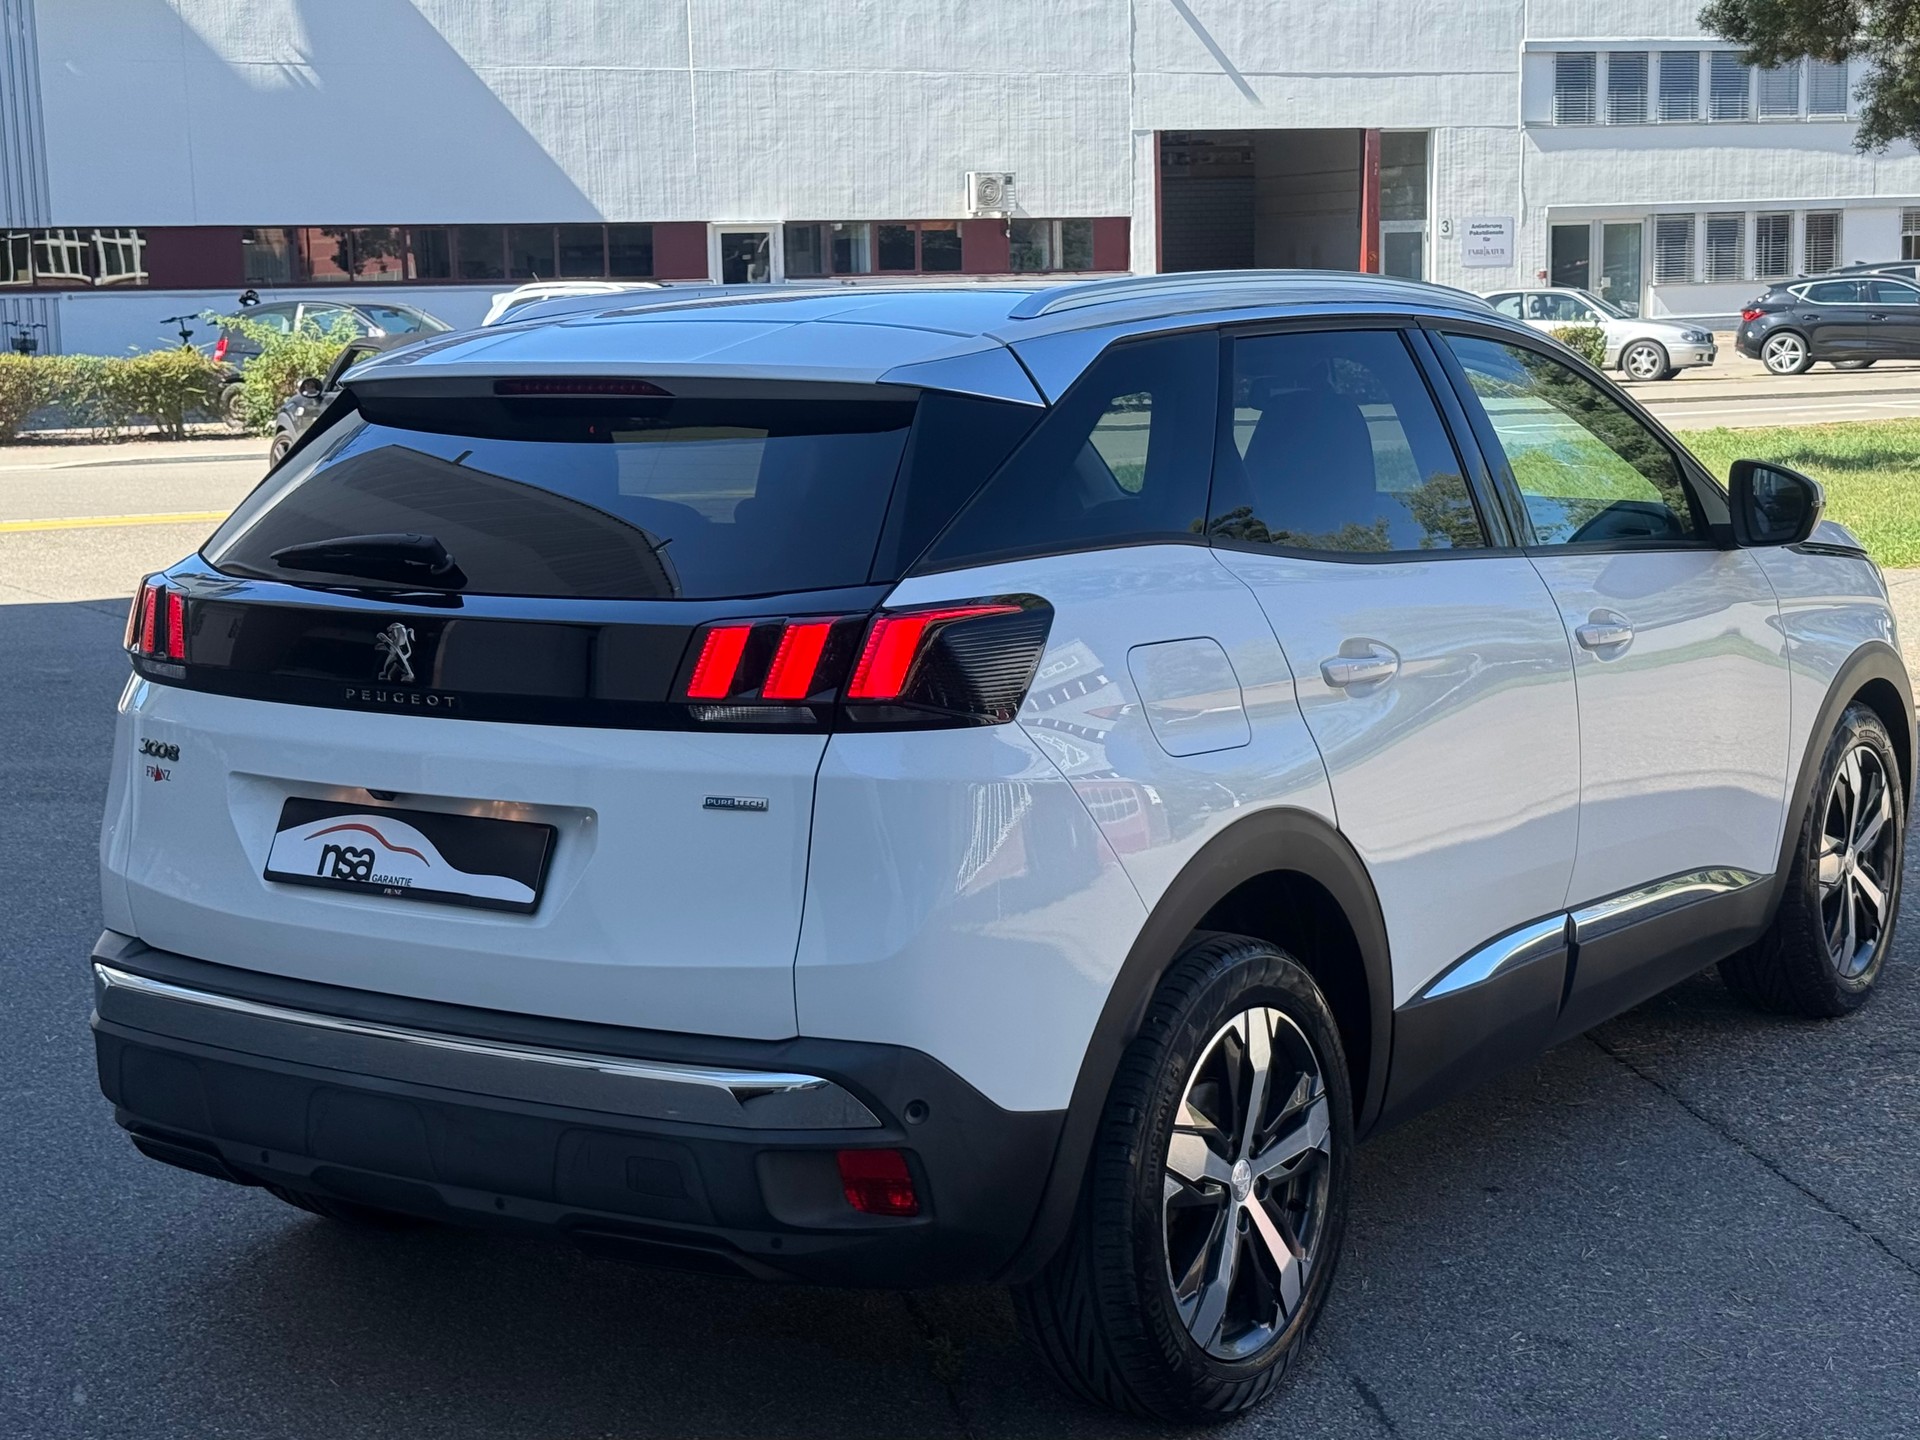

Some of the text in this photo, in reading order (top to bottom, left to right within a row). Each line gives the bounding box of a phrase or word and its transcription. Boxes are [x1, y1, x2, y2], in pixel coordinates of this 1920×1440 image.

[1441, 220, 1450, 233] 3
[345, 688, 455, 707] PEUGEOT
[138, 737, 180, 762] 3008
[317, 844, 376, 882] nsa
[371, 873, 413, 887] GARANTIE
